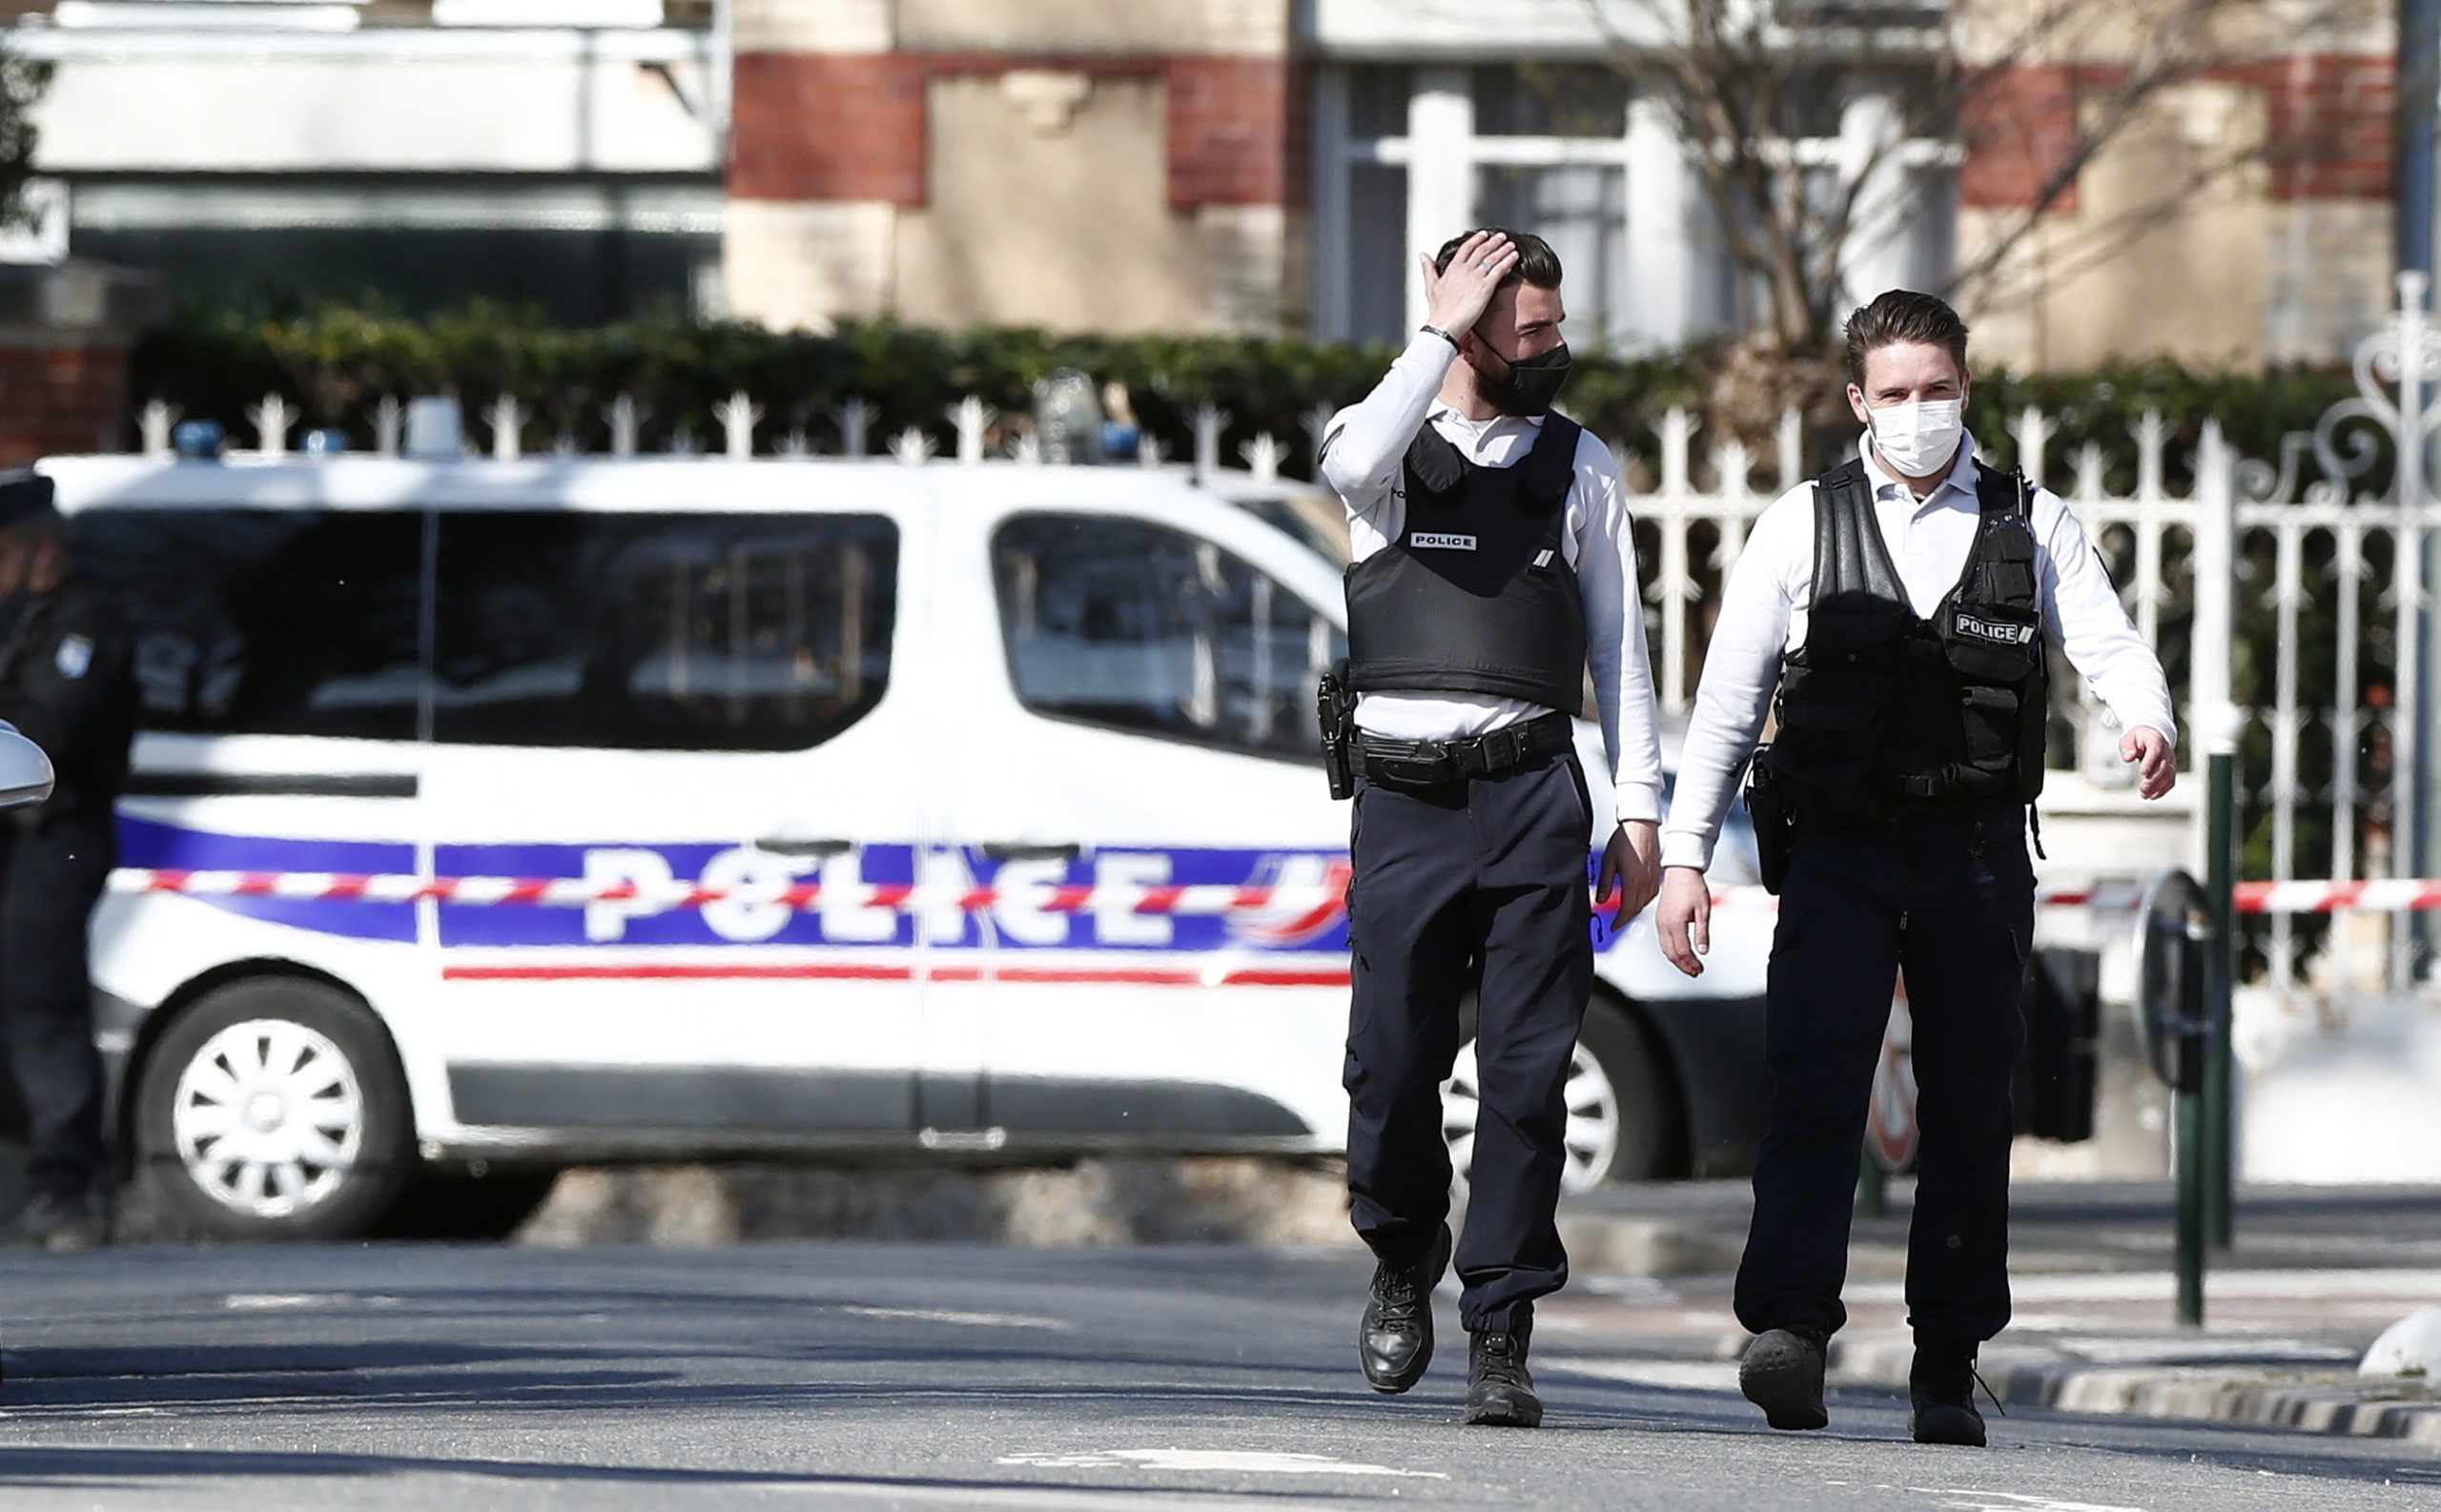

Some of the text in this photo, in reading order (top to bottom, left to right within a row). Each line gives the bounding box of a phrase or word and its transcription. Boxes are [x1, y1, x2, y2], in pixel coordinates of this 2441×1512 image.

[1416, 536, 1472, 546] POLICE
[1959, 618, 2016, 641] POLICE
[584, 848, 1173, 944] POLICE
